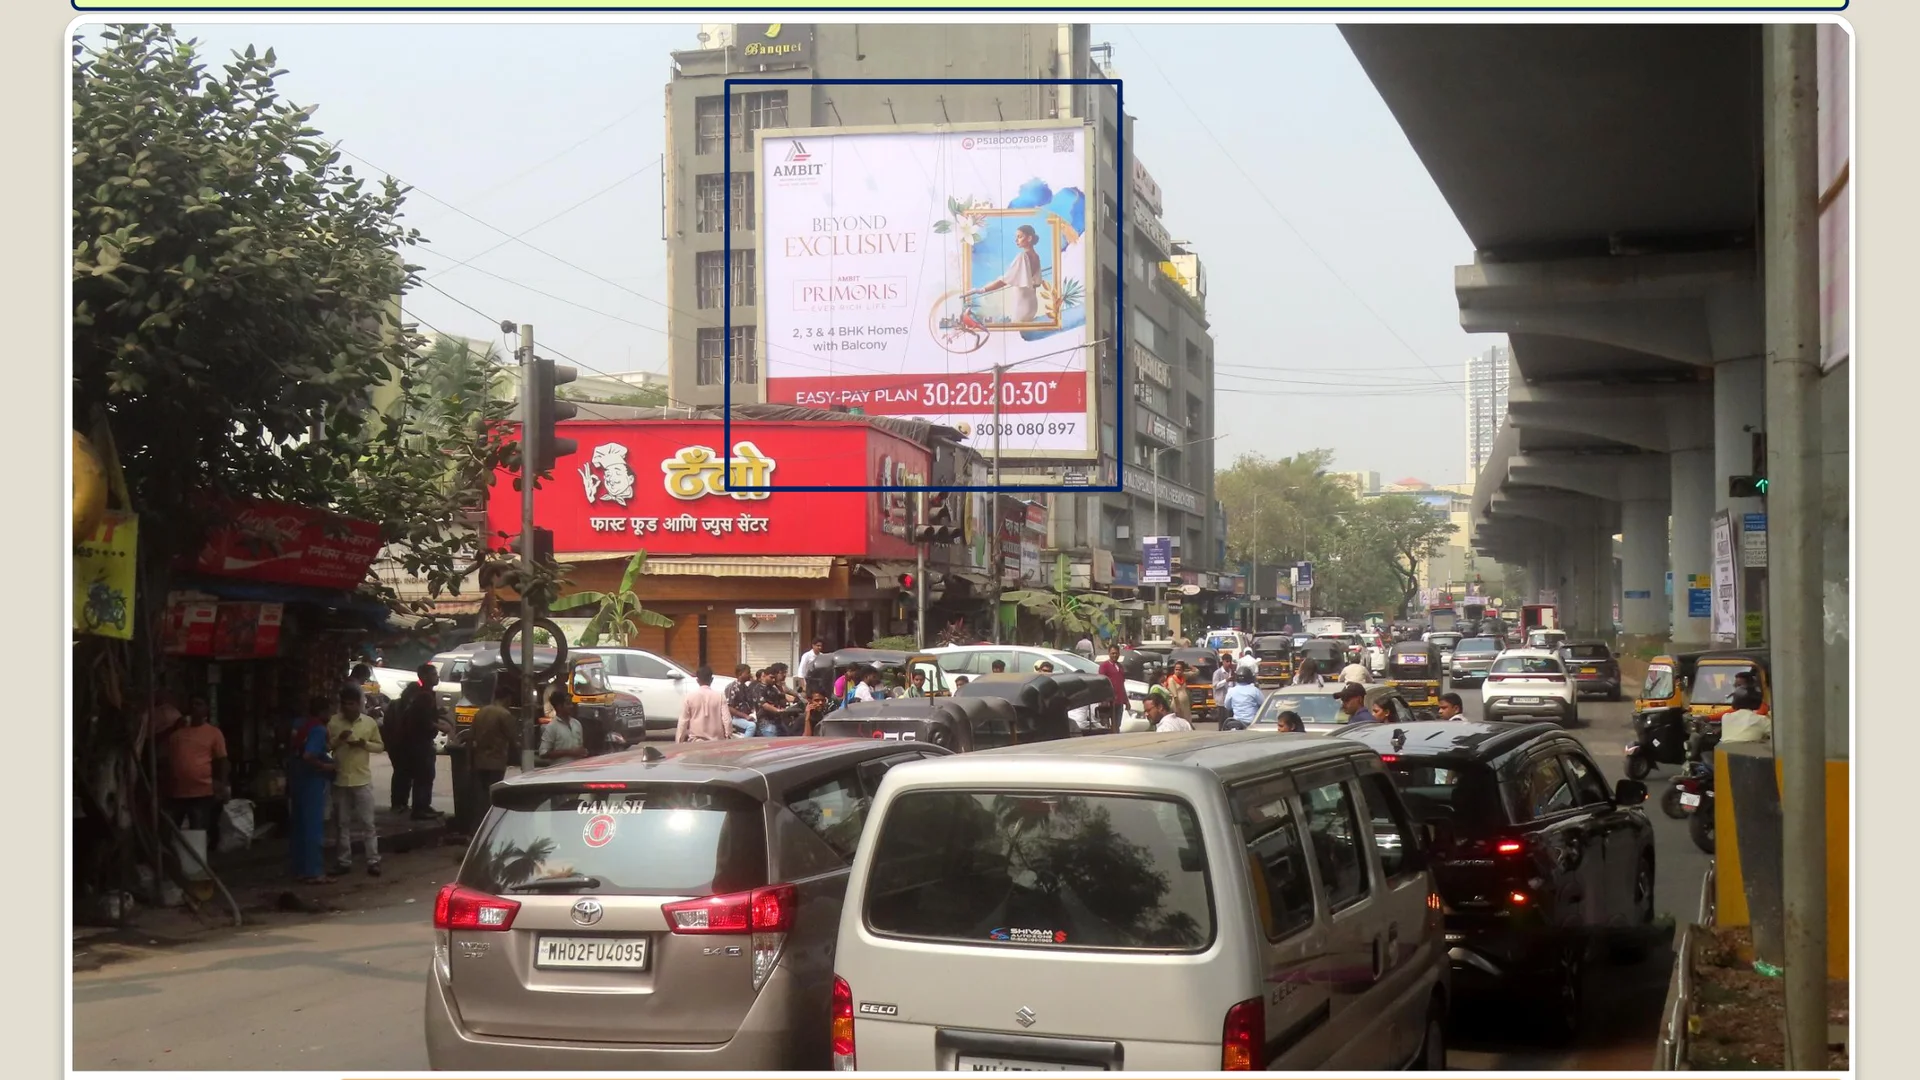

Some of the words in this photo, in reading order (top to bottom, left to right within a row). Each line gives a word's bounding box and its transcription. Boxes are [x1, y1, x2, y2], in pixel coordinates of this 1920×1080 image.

[744, 42, 802, 56] Banquet
[977, 135, 1048, 145] P51800078969
[773, 164, 823, 177] AMBIT
[812, 215, 887, 232] BEYOND
[785, 232, 917, 258] EXCLUSIVE
[803, 283, 899, 303] PRIMORIS
[811, 304, 836, 312] EVER
[792, 328, 803, 339] 2,
[806, 328, 813, 338] 3
[816, 328, 824, 337] &
[828, 327, 835, 337] 4
[839, 326, 864, 337] BHK
[867, 325, 908, 336] Homes
[813, 340, 838, 351] with
[841, 340, 888, 352] Balcony
[796, 390, 871, 405] EASY-PAY
[875, 388, 918, 403] PLAN
[1016, 423, 1045, 436] 080
[1048, 422, 1076, 435] 897
[590, 516, 627, 532] फास्ट
[630, 516, 659, 535] फूड
[662, 513, 698, 532] आणि
[701, 516, 734, 536] ज्युस
[736, 512, 769, 532] सेंटर
[577, 799, 647, 815] GANESH
[1010, 928, 1053, 936] SHIVAM
[548, 943, 643, 962] MH02FU4095
[860, 1003, 897, 1014] EECO
